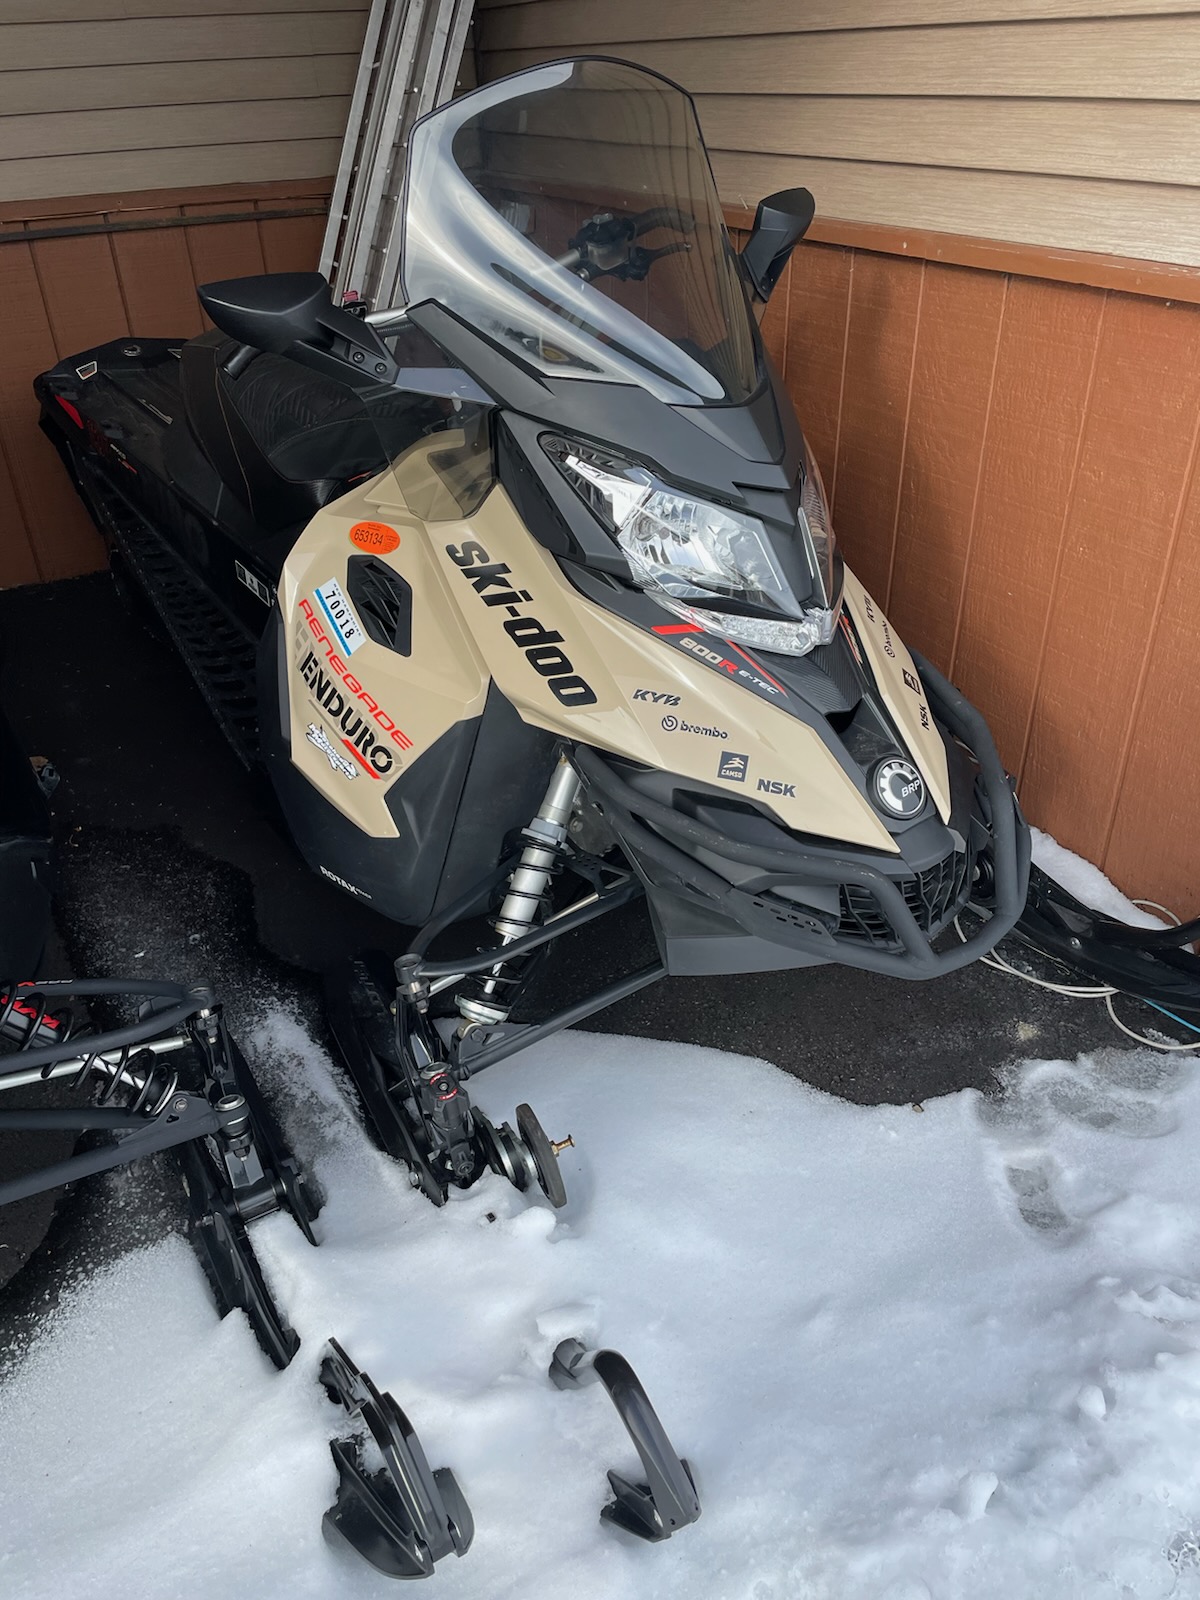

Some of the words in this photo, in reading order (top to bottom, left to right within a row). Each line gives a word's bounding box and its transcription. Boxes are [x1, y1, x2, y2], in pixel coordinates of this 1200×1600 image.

[354, 528, 384, 546] 653134
[325, 590, 355, 639] 70018
[445, 541, 598, 707] ski-doo
[298, 598, 414, 751] RENEGADE
[679, 637, 739, 675] 800R
[738, 669, 780, 695] E-TEC
[632, 688, 682, 707] KYB
[300, 651, 393, 774] ENDURO
[680, 720, 729, 740] brembo
[720, 769, 743, 779] CAMSO
[756, 778, 797, 798] NSK
[901, 779, 921, 798] BRP
